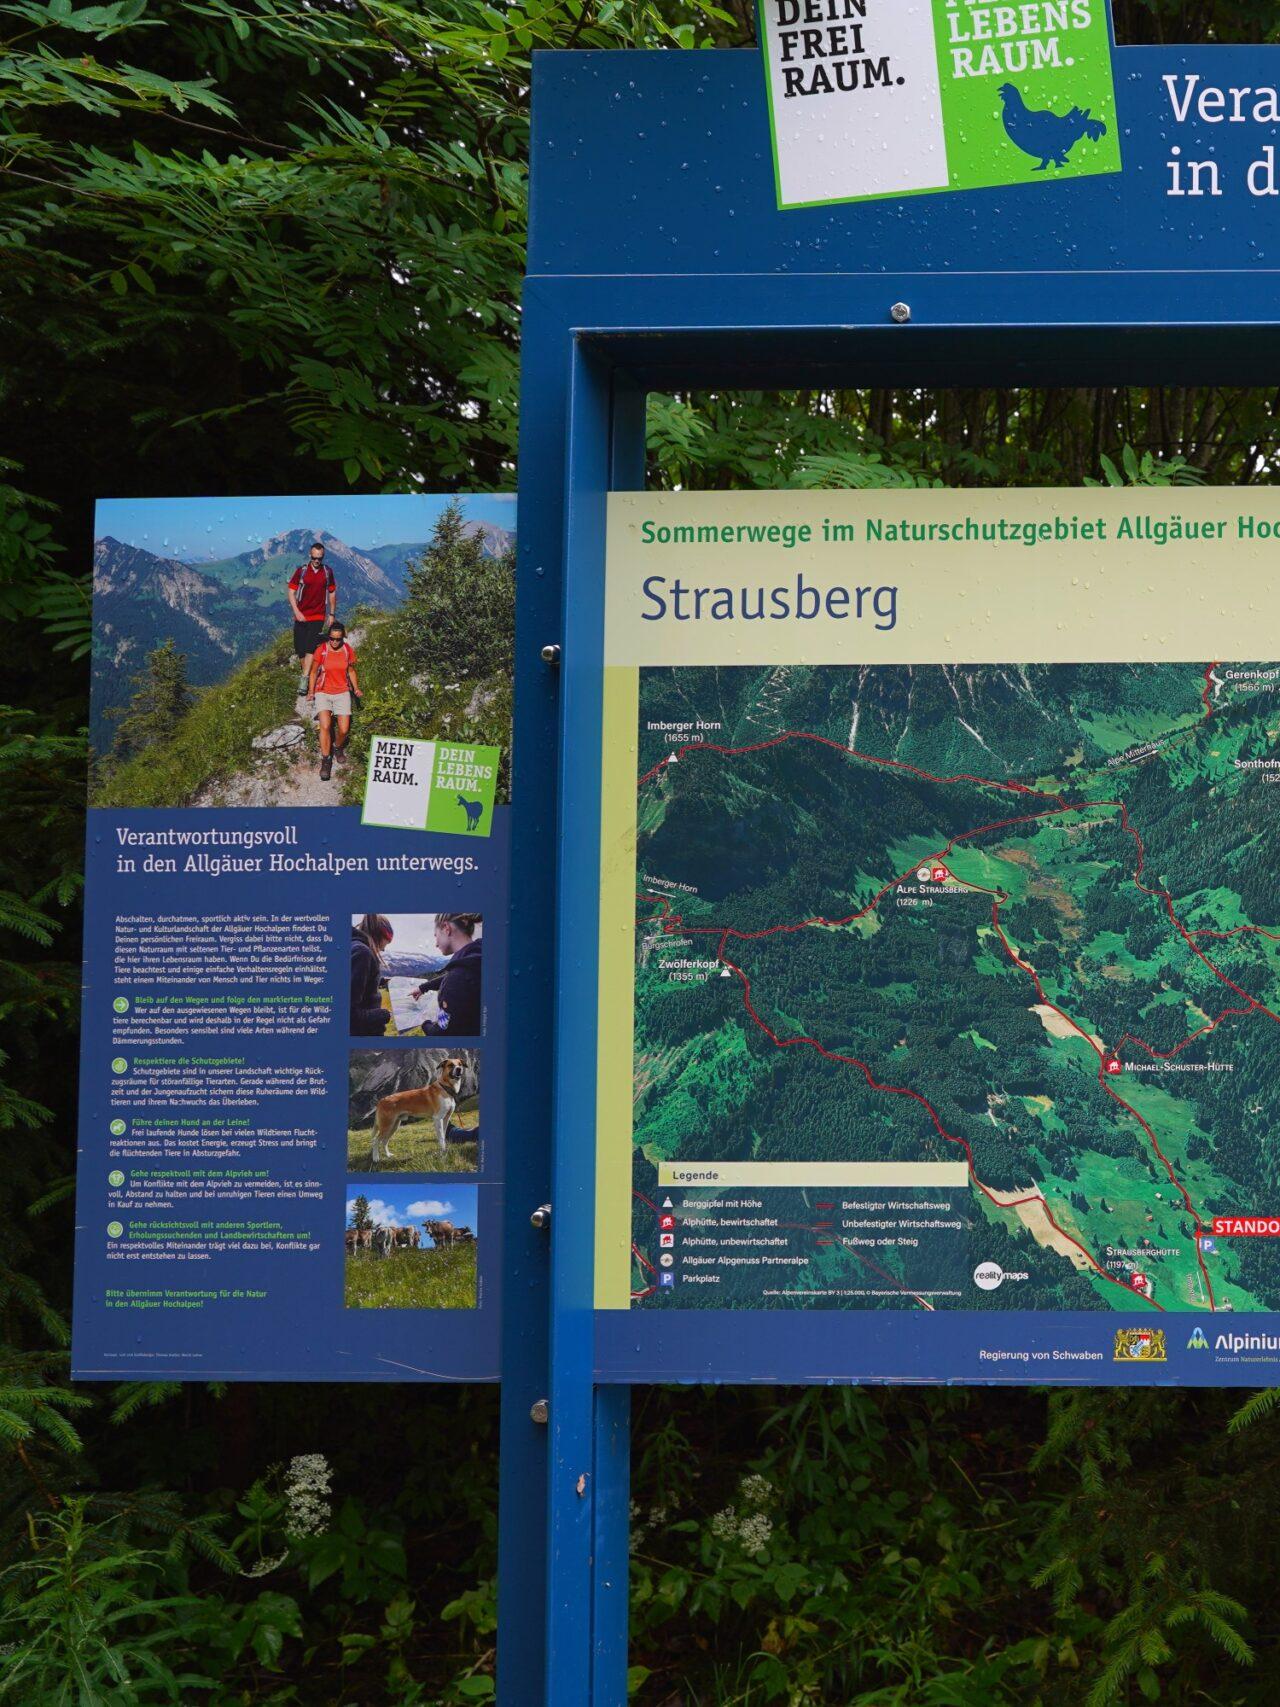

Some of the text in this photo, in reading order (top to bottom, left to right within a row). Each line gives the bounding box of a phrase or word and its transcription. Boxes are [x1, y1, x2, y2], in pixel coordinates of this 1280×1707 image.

[777, 0, 867, 26] DEIN
[948, 0, 1093, 43] LEBENS
[778, 24, 865, 61] FREI
[951, 37, 1075, 79] RAUM.
[782, 56, 905, 98] RAUM.
[1167, 146, 1222, 195] in
[642, 520, 811, 546] Sommerwege
[822, 518, 854, 541] im
[867, 516, 1107, 546] Naturschutzgebiet
[1117, 515, 1227, 545] Allgäuer
[642, 573, 897, 631] Strausberg
[1225, 670, 1280, 680] Gerenkopf
[1262, 683, 1275, 692] m)
[648, 721, 721, 732] Imberger Horn
[665, 734, 703, 742] (1655 m)
[376, 741, 414, 757] MEIN
[440, 747, 476, 763] DEIN
[374, 756, 407, 770] FREI
[438, 762, 493, 779] LEBENS
[372, 770, 418, 786] RAUM.
[435, 776, 482, 792] RAUM.
[117, 825, 297, 849] Verantwortungsvoll
[117, 853, 478, 877] in den Allgäuer Hochalpen unterwegs.
[643, 874, 698, 894] Imberger Horn
[897, 898, 933, 907] (1226 m)
[157, 915, 199, 923] durchatmen,
[201, 915, 231, 923] sportlich
[271, 914, 279, 922] In
[659, 959, 720, 970] Zwölferkopf
[669, 972, 708, 981] (1355 m)
[1125, 1062, 1233, 1071] MICHAEL-SCHUSTER-HÜTTE
[132, 1118, 152, 1126] Führe
[154, 1118, 179, 1126] deinen
[181, 1118, 200, 1126] Hund
[227, 1118, 250, 1126] Leine!
[673, 1171, 718, 1182] Legende
[683, 1200, 724, 1209] Berggipfel
[742, 1200, 762, 1208] Höhe
[842, 1201, 951, 1211] Befestigter Wirtschaftsweg
[683, 1219, 719, 1227] Alphütte,
[842, 1220, 962, 1230] Unbefestigter Wirtschaftsweg
[683, 1238, 788, 1246] Alphütte, unbewirtschaftet
[843, 1237, 875, 1247] Fußweg
[898, 1237, 918, 1247] Steig
[1204, 1241, 1212, 1249] P
[682, 1256, 809, 1266] Allgäuer Alpgenuss Partneralpe
[664, 1274, 671, 1283] P
[683, 1274, 720, 1284] Parkplatz
[980, 1350, 1103, 1362] Regierung von Schwaben
